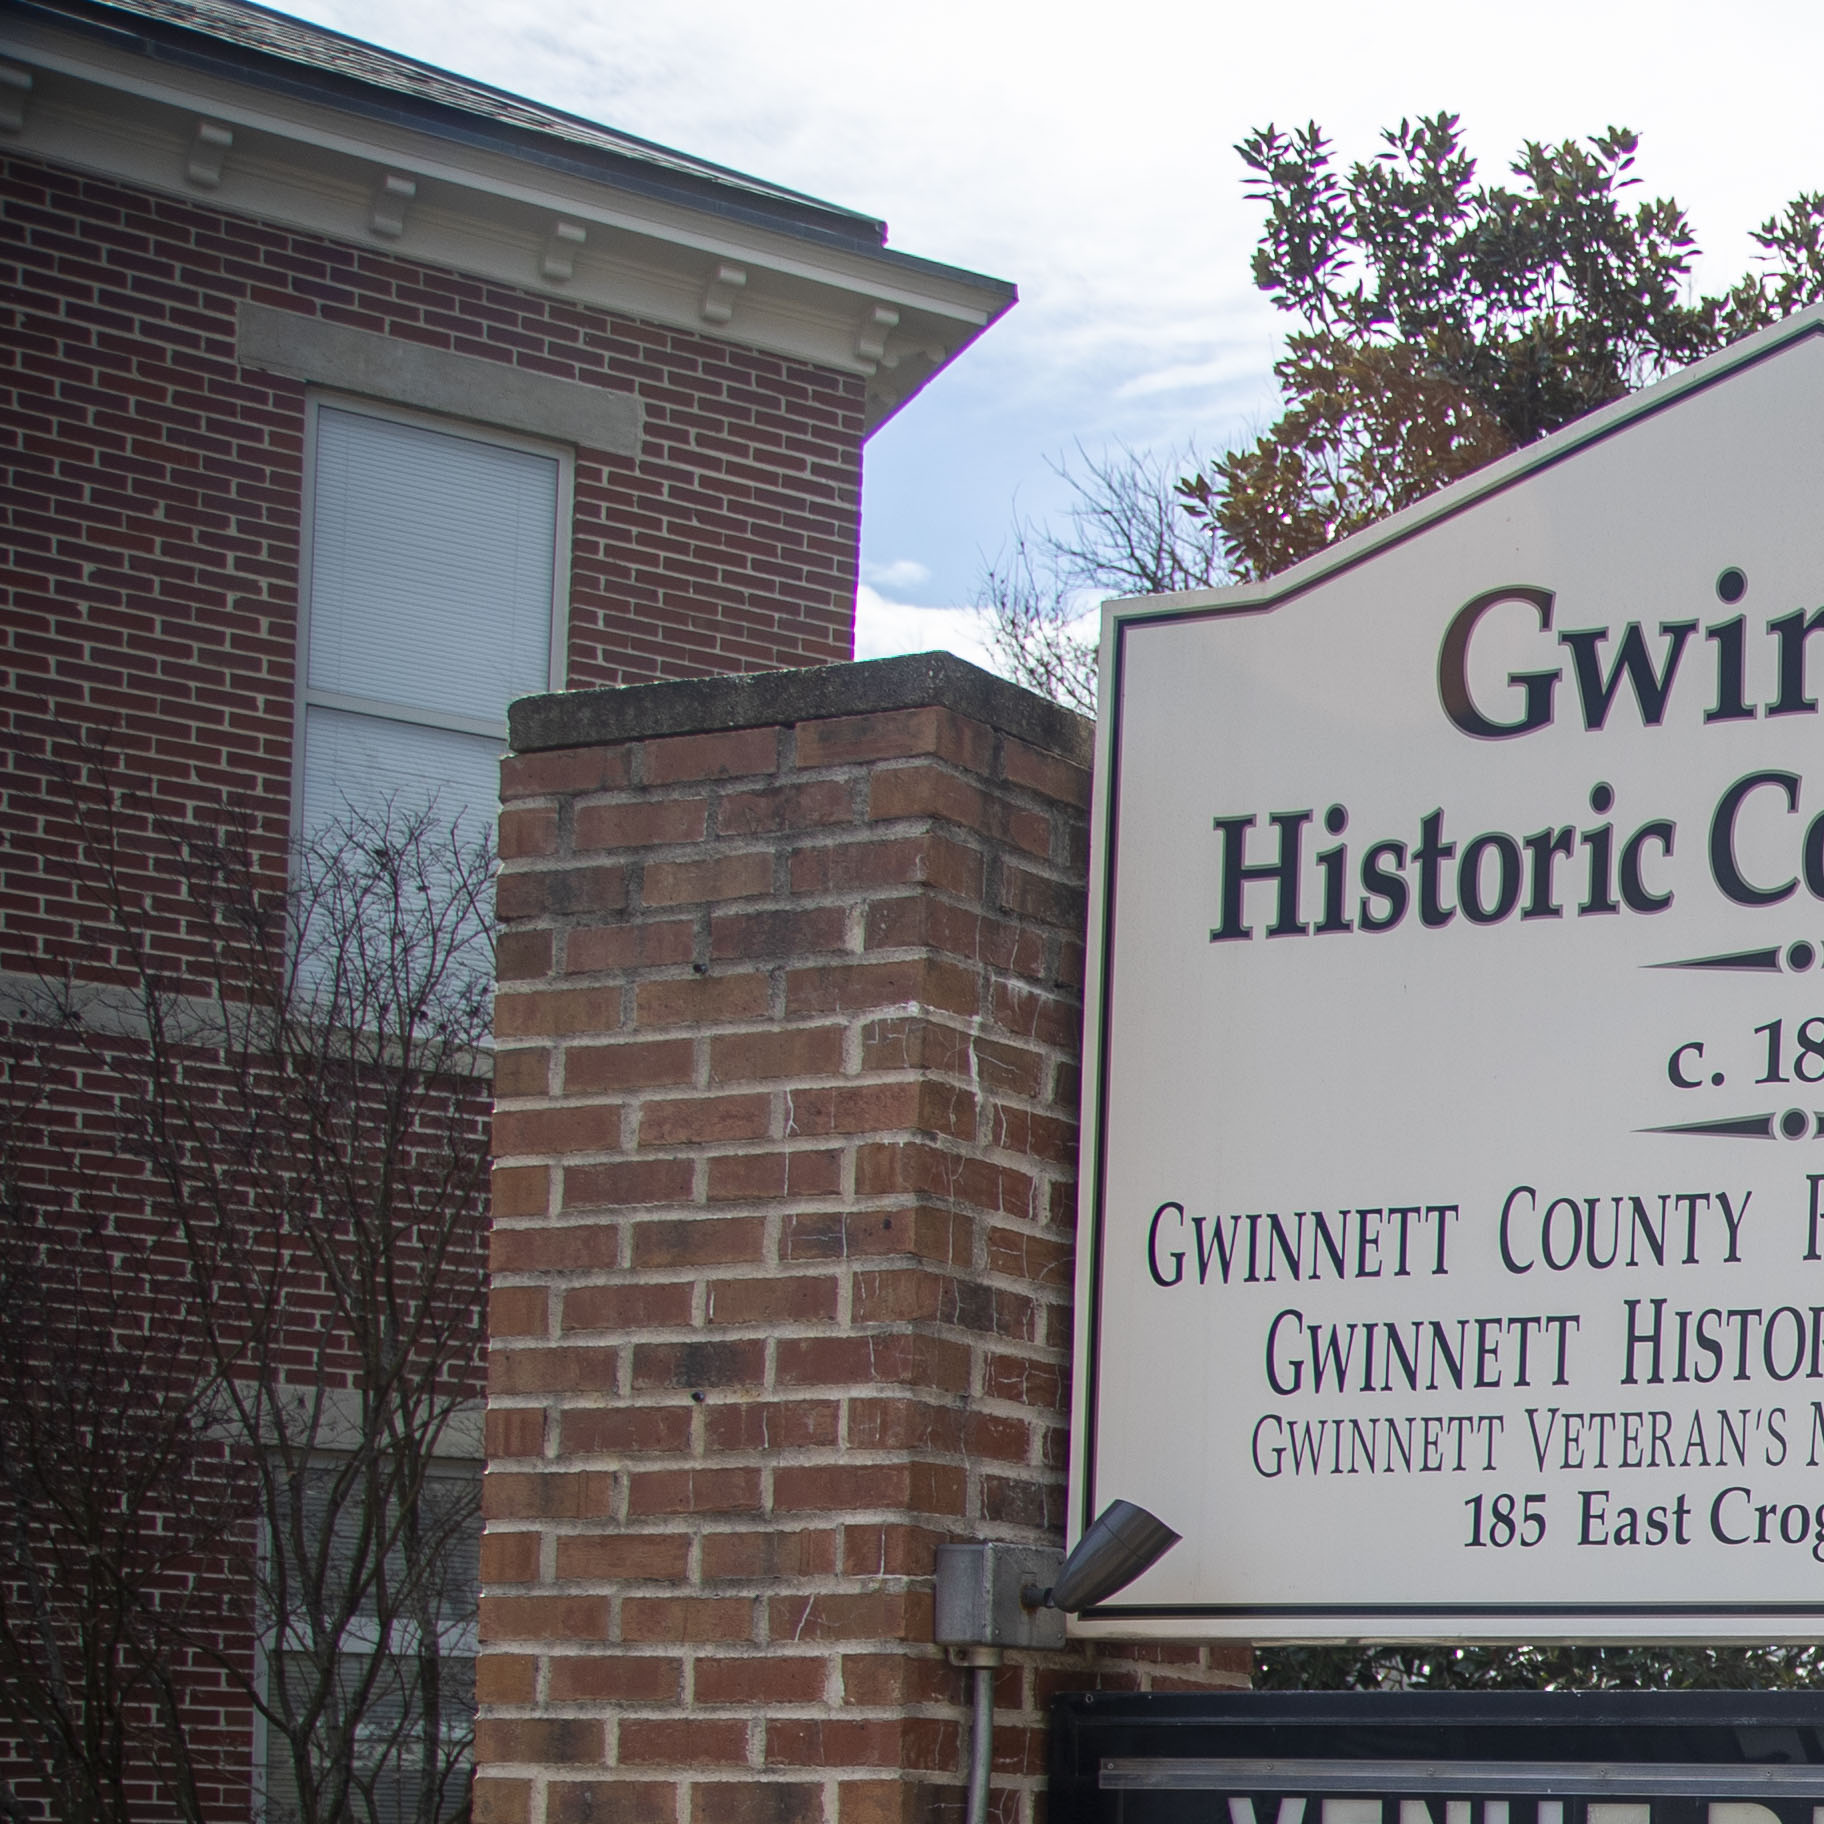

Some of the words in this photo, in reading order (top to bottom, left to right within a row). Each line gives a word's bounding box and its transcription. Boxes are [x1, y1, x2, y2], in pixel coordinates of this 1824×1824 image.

[1210, 782, 1676, 943] Historic
[1667, 1040, 1726, 1089] c.
[1148, 1202, 1458, 1287] GWINNETT
[1500, 1186, 1752, 1274] COUNTY
[1266, 1309, 1580, 1395] GWINNETT
[1253, 1414, 1503, 1477] GWINNETT
[1525, 1408, 1786, 1472] VETERAN'S
[1465, 1494, 1545, 1547] 185
[1578, 1491, 1691, 1545] East
